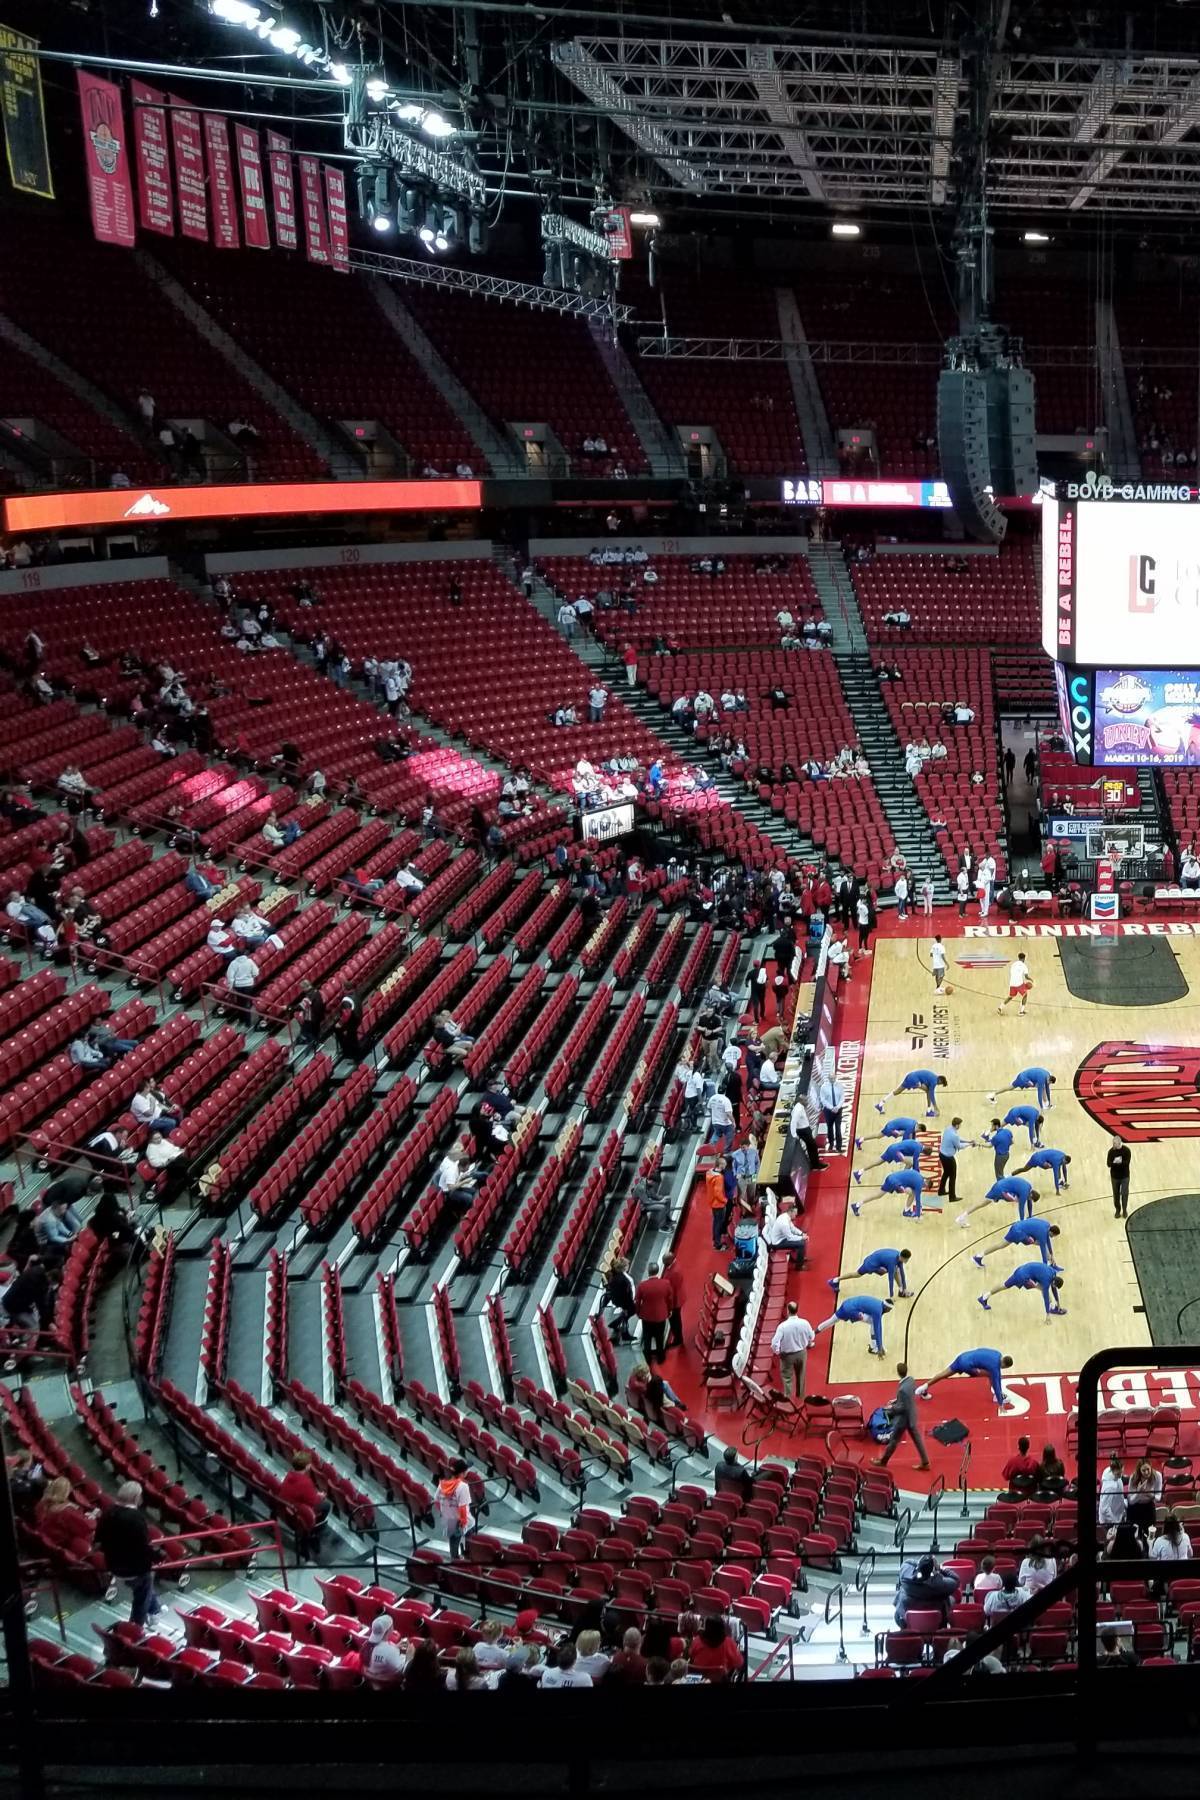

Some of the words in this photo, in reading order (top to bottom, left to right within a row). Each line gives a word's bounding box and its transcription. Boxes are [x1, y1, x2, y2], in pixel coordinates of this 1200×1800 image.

[1067, 484, 1114, 499] BOYD
[1121, 485, 1190, 501] GAMING
[342, 548, 360, 562] 120
[661, 541, 680, 552] 121
[1059, 512, 1073, 586] REBEL.
[1059, 593, 1072, 611] A
[1059, 618, 1072, 645] BE
[1071, 676, 1091, 755] COX
[1103, 722, 1151, 749] UNLV
[1104, 754, 1134, 763] MARCH
[1137, 754, 1161, 765] 10-16,
[1163, 754, 1184, 763] 2019
[1106, 789, 1121, 801] 30
[964, 924, 1107, 937] RUNNIN'
[932, 1005, 950, 1025] FIRST
[932, 1026, 950, 1059] AMERICA
